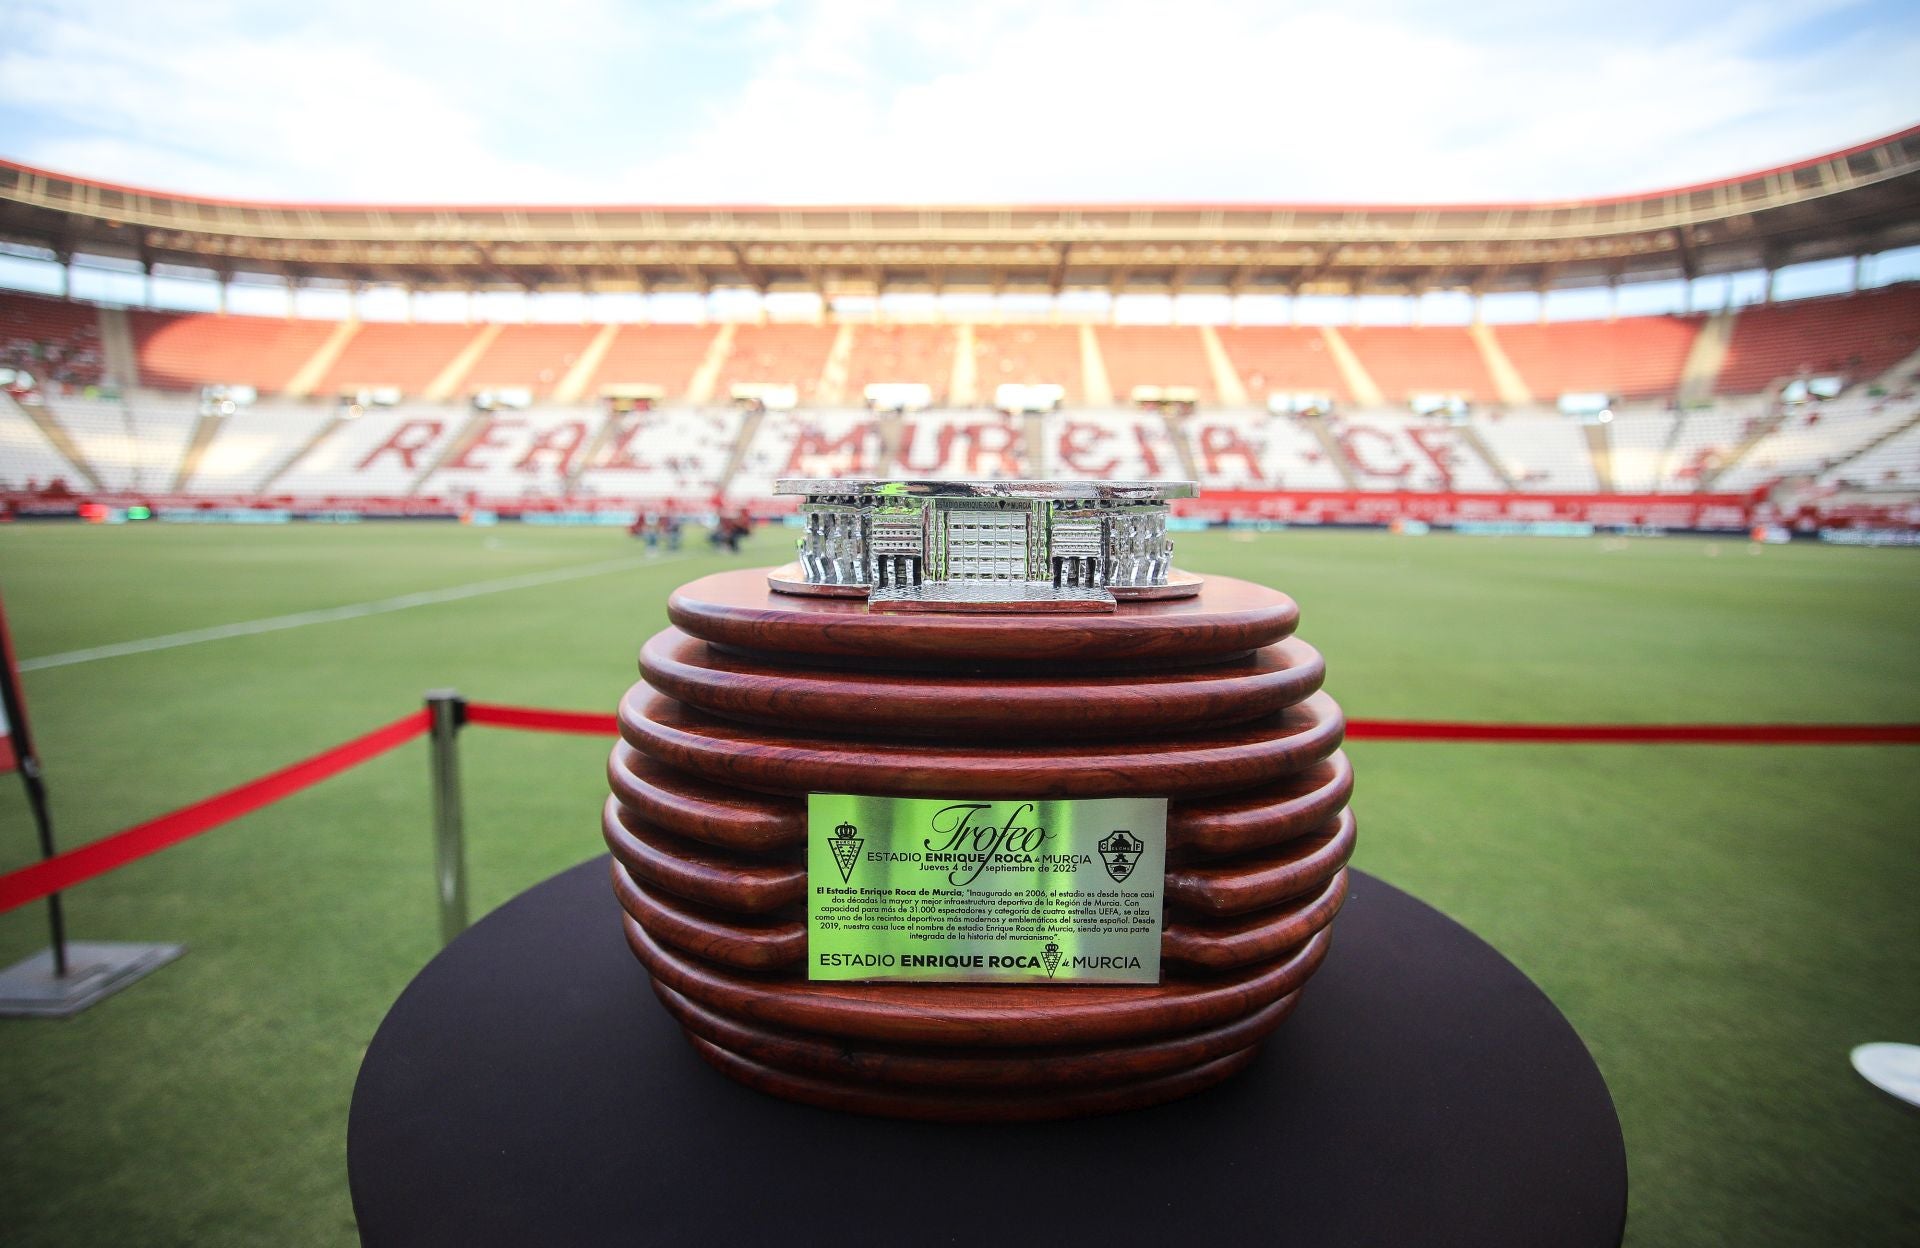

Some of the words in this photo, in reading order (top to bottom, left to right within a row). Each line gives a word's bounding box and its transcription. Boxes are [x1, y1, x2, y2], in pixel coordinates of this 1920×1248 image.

[354, 420, 652, 476] REAL
[785, 417, 1264, 479] MURCIA
[1338, 425, 1458, 489] CF
[924, 803, 1057, 887] Trofeo
[867, 852, 922, 862] ESTADIO
[926, 853, 985, 863] ENRIQUE
[994, 854, 1033, 863] ROCA
[1042, 855, 1092, 864] MURCIA
[919, 862, 949, 871] Jueves
[953, 863, 958, 871] 4
[962, 863, 973, 871] de
[986, 863, 1035, 874] septiembre
[1038, 864, 1049, 872] de
[1053, 864, 1077, 872] 2025
[817, 887, 824, 895] El
[826, 887, 857, 896] Estadio
[860, 888, 893, 898] Enrique
[919, 888, 930, 896] de
[1025, 890, 1047, 898] 2006,
[1058, 890, 1085, 898] estadio
[1097, 890, 1119, 898] desde
[831, 896, 844, 904] dos
[889, 899, 912, 907] mayor
[921, 897, 942, 907] mejor
[944, 898, 995, 906] infraestructura
[998, 898, 1032, 907] deportiva
[1034, 898, 1044, 906] de
[1046, 898, 1053, 906] la
[1055, 899, 1080, 908] Región
[1082, 899, 1092, 907] de
[1095, 899, 1122, 907] Murcia.
[821, 905, 860, 914] capacidad
[861, 907, 879, 915] para
[881, 905, 896, 913] más
[898, 905, 907, 913] de
[909, 906, 936, 914] 31.000
[938, 907, 986, 915] espectadores
[1031, 907, 1041, 915] de
[1068, 908, 1096, 916] estrellas
[1099, 908, 1121, 916] UEFA,
[1134, 908, 1150, 916] alza
[853, 913, 862, 921] de
[864, 913, 875, 921] los
[877, 914, 905, 922] recintos
[906, 914, 945, 924] deportivos
[947, 914, 962, 923] más
[964, 915, 1000, 923] modernos
[1008, 916, 1058, 924] emblemáticos
[1059, 916, 1071, 924] del
[1099, 916, 1130, 925] español.
[820, 922, 841, 931] 2019,
[890, 922, 905, 931] luce
[907, 923, 914, 931] el
[916, 923, 944, 931] nombre
[946, 923, 956, 931] de
[957, 924, 984, 932] estadio
[986, 924, 1013, 933] Enrique
[1036, 924, 1045, 932] de
[1048, 925, 1075, 933] Murcia,
[1077, 925, 1101, 933] siendo
[1130, 926, 1150, 934] parte
[909, 933, 945, 941] integrada
[946, 933, 956, 941] de
[820, 953, 895, 967] ESTADIO
[900, 954, 984, 968] ENRIQUE
[988, 955, 1041, 968] ROCA
[1072, 956, 1141, 969] MURCIA
